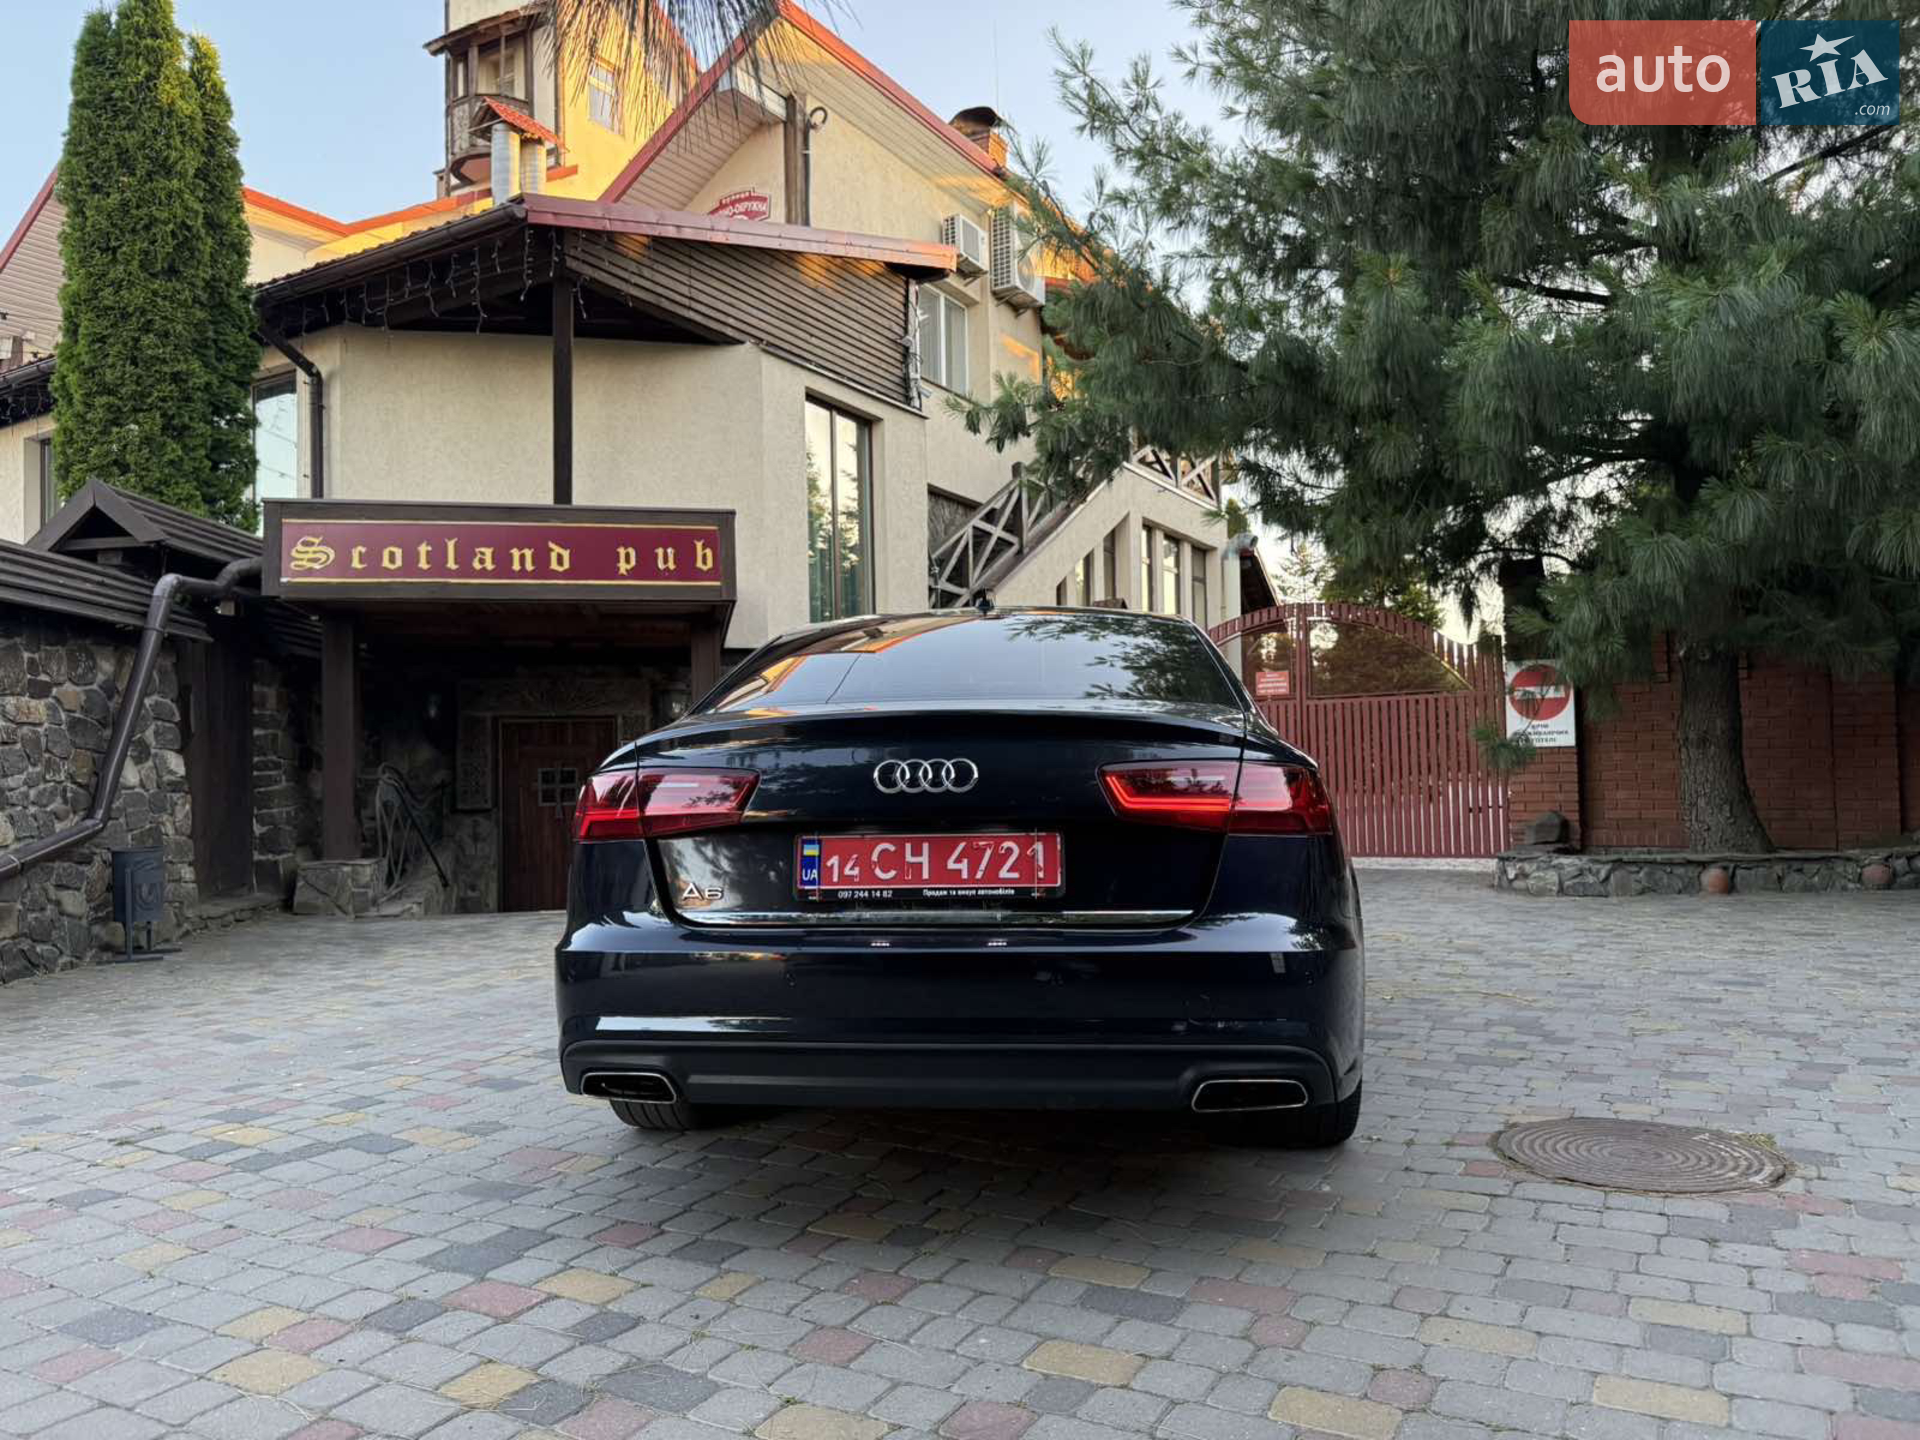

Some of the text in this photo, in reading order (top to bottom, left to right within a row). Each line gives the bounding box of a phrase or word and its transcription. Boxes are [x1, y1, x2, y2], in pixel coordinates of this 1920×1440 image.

[288, 535, 715, 576] Scotland pub
[825, 854, 861, 883] 14
[946, 841, 1046, 880] 4721
[802, 867, 818, 881] UA
[681, 882, 725, 901] A6
[837, 890, 853, 899] 097
[854, 890, 869, 898] 244
[871, 890, 881, 898] 14
